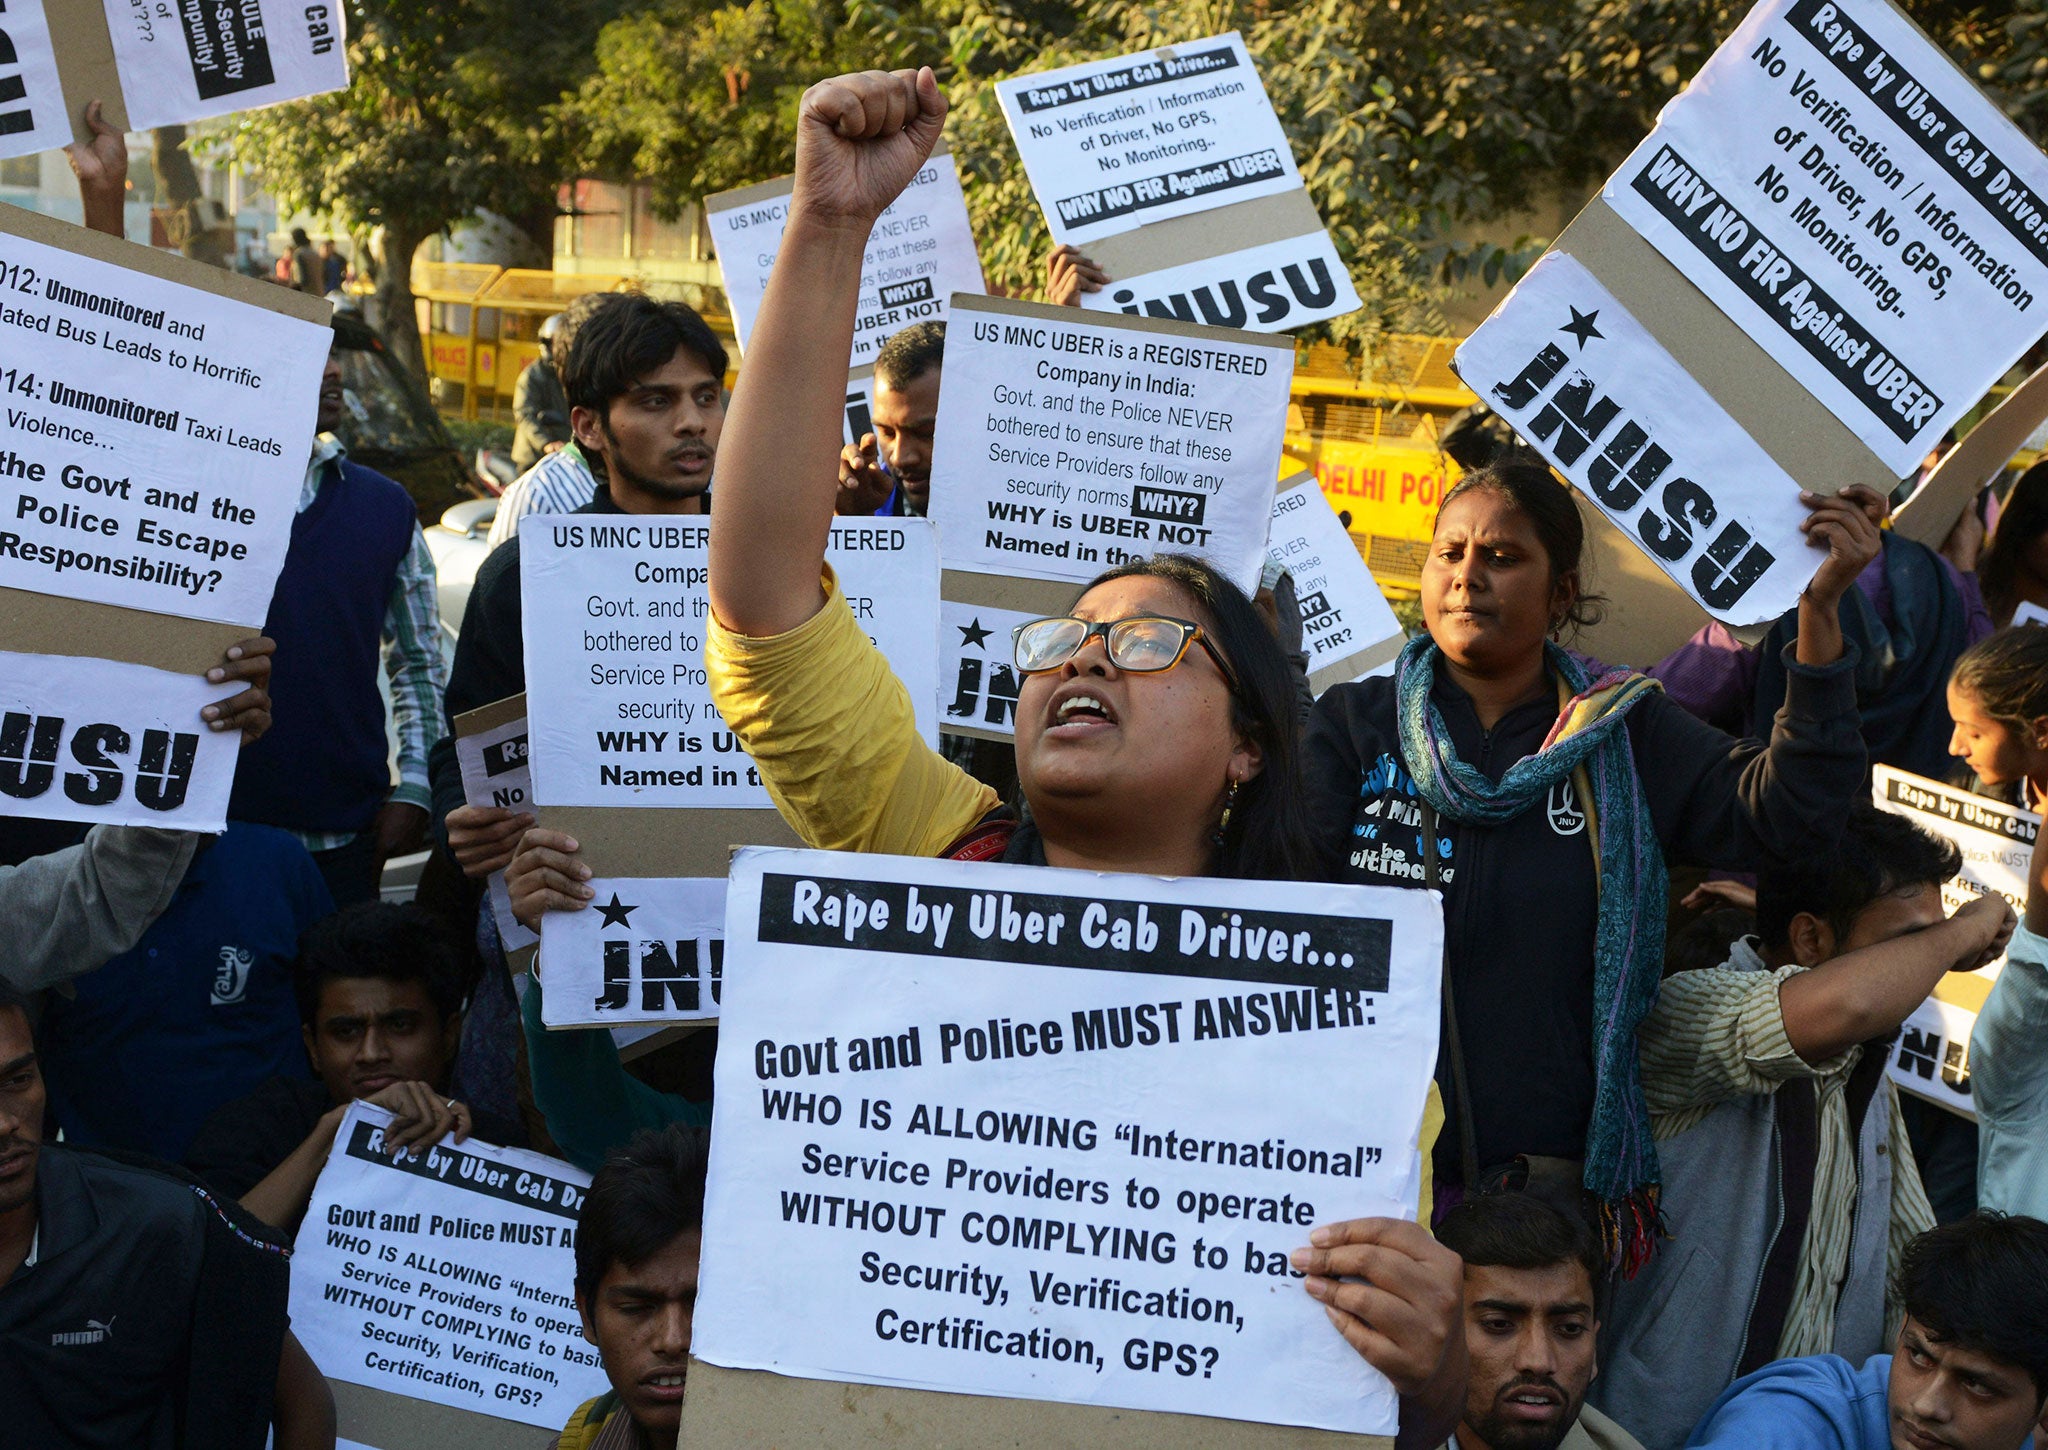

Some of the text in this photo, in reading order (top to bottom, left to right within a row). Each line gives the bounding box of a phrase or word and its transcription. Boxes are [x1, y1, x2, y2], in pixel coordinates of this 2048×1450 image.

[1027, 55, 1227, 107] Rape by Uber Cab Driver...
[1810, 2, 1990, 178] Rape by Uber Cab
[1030, 81, 1245, 139] No Verification Information
[1057, 149, 1282, 222] WHY UBER
[1751, 37, 2034, 312] No Verification Information
[728, 210, 749, 230] US
[751, 206, 782, 226] MNC
[882, 215, 930, 236] NEVER
[1774, 125, 1952, 300] of No GPS,
[877, 244, 900, 263] that
[902, 237, 937, 256] these
[1754, 164, 1906, 318] No Monitoring..
[877, 259, 938, 283] follow any
[883, 280, 928, 305] WHY?
[1647, 149, 1938, 430] WHY NO FIR Against UBER
[45, 278, 205, 341] Unmonitored and
[906, 299, 943, 320] NOT
[56, 318, 97, 346] Bus
[103, 331, 162, 363] Leads
[192, 355, 262, 389] Horrific
[855, 341, 870, 354] in
[974, 321, 1268, 376] US MNC UBER REGISTERED
[1036, 360, 1196, 398] Company India:
[7, 407, 116, 451] Violence...
[49, 380, 282, 457] Unmonitored Taxi Leads
[1042, 393, 1234, 433] and the Police NEVER
[987, 413, 1232, 463] bothered ensure that these
[988, 442, 1188, 486] Service Providers follow
[1315, 460, 1386, 502] DELHI
[1491, 341, 1777, 611] JNUSU
[60, 463, 131, 502] Govt
[144, 486, 199, 514] and
[212, 496, 256, 526] the
[1006, 477, 1200, 519] security WHY?
[16, 494, 248, 562] Police Escape
[553, 526, 641, 548] US MNC
[985, 529, 1070, 559] Named
[987, 500, 1212, 548] WHY UBER NOT
[0, 531, 222, 596] Responsibility?
[1306, 574, 1328, 595] any
[648, 596, 683, 618] and
[1305, 608, 1343, 635] NOT
[584, 630, 698, 651] bothered to
[1313, 627, 1353, 654] FIR?
[590, 663, 665, 686] Service
[618, 699, 694, 724] security
[597, 731, 669, 753] WHY
[678, 731, 702, 753] is
[492, 787, 524, 808] No
[600, 765, 702, 786] Named
[712, 765, 737, 786] in
[1557, 817, 1576, 826] JNU
[1940, 795, 1960, 819] by
[1963, 803, 2001, 829] Uber
[2005, 816, 2036, 840] Cab
[1381, 843, 1405, 861] be
[1992, 850, 2030, 867] MUST
[1944, 893, 1960, 906] to
[793, 880, 1354, 969] Rape by Uber Cab Driver...
[755, 987, 1376, 1081] Govt and Police MUST ANSWER:
[762, 1088, 1382, 1178] WHO IS ALLOWING “International”
[459, 1156, 554, 1202] Uber Cab
[802, 1143, 1315, 1226] Service Providers to operate
[327, 1203, 375, 1229] Govt
[380, 1213, 420, 1234] and
[429, 1215, 494, 1241] Police
[500, 1222, 557, 1247] MUST
[780, 1190, 1228, 1270] WITHOUT COMPLYING to
[326, 1229, 502, 1291] WHO IS ALLOWING
[341, 1262, 502, 1318] Service Providers
[859, 1251, 1244, 1333] Security, Verification,
[52, 1331, 104, 1346] PUMA
[324, 1283, 531, 1350] WITHOUT COMPLYING
[361, 1321, 559, 1387] Security, Verification,
[875, 1308, 1219, 1379] Certification, GPS?
[364, 1351, 543, 1408] Certification, GPS?
